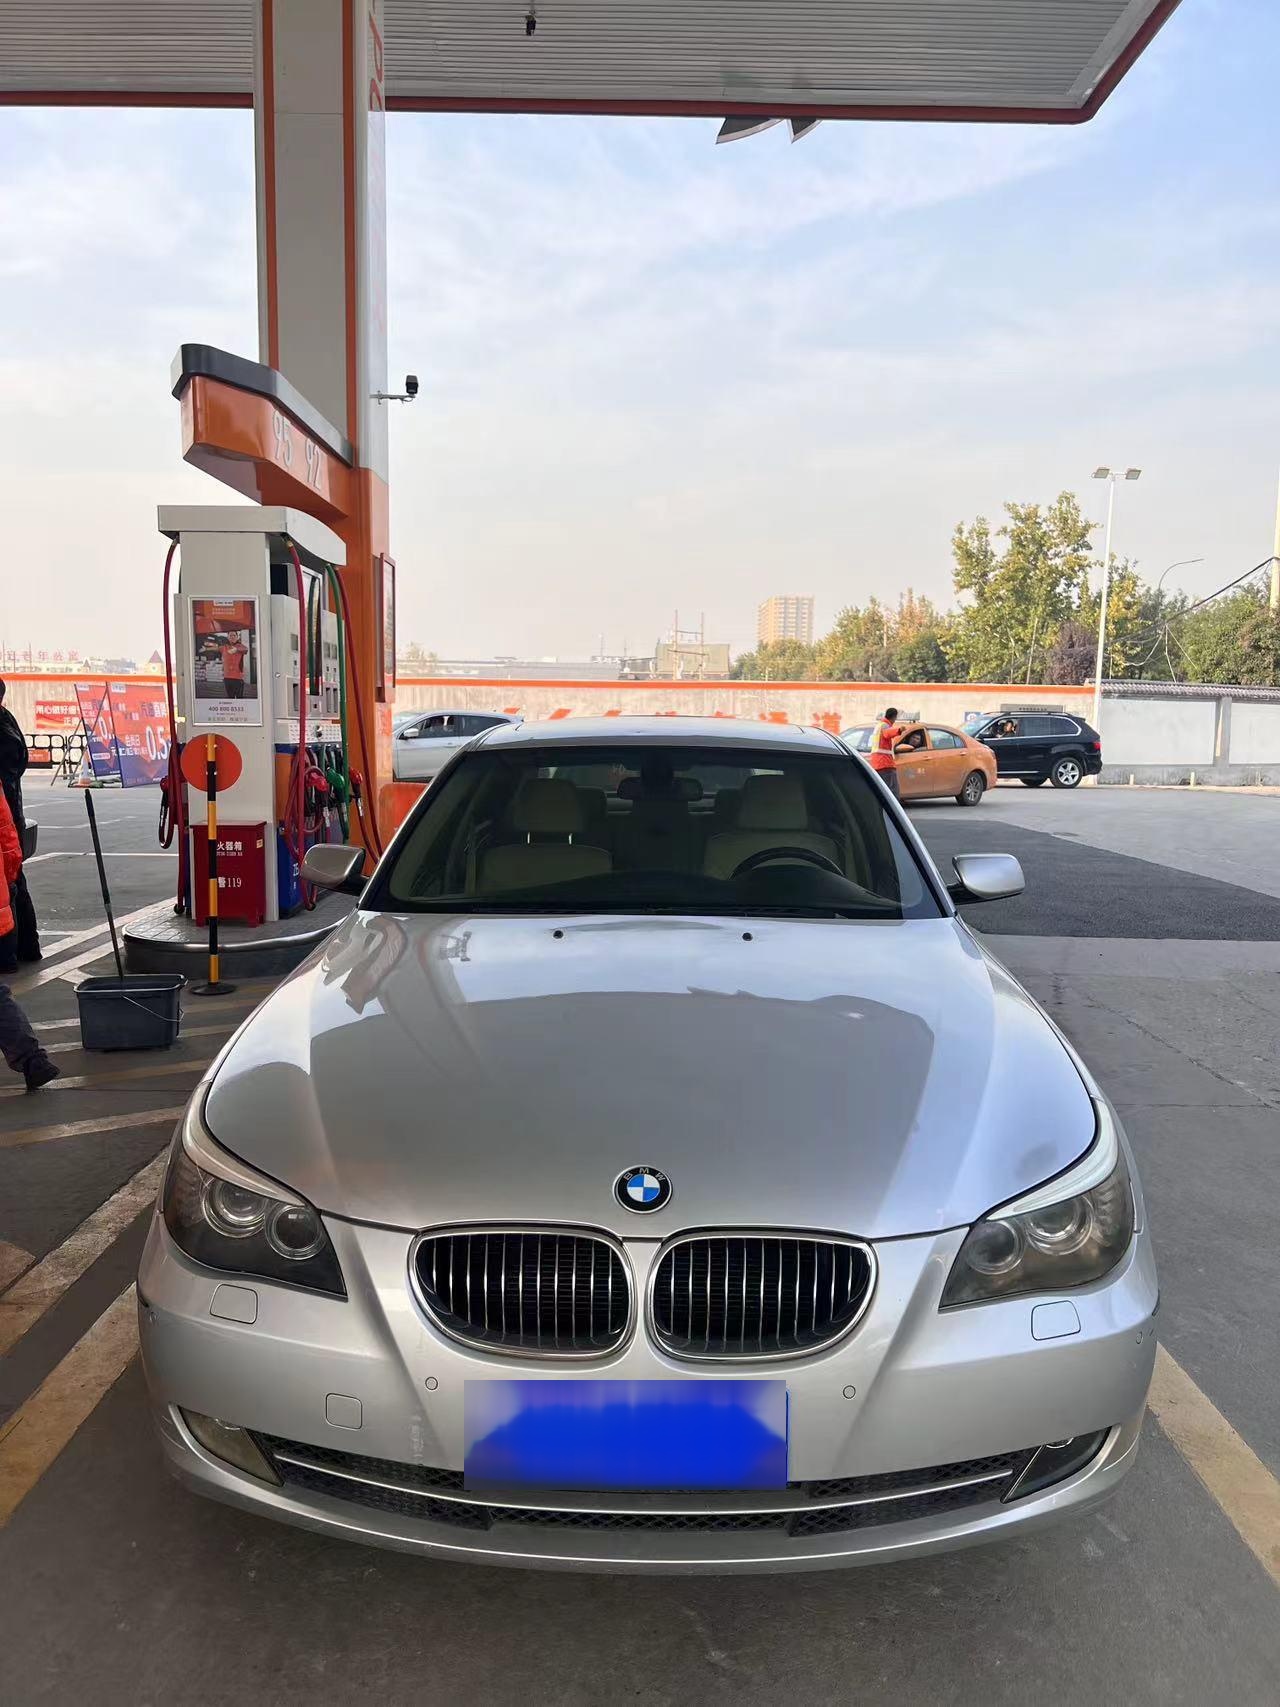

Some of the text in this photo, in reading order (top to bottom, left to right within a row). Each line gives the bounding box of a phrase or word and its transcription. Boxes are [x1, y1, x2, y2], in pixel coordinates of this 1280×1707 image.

[272, 409, 322, 491] 95 92
[216, 841, 243, 851] 火器箱
[218, 876, 242, 888] 警119
[623, 1167, 667, 1181] BMW
